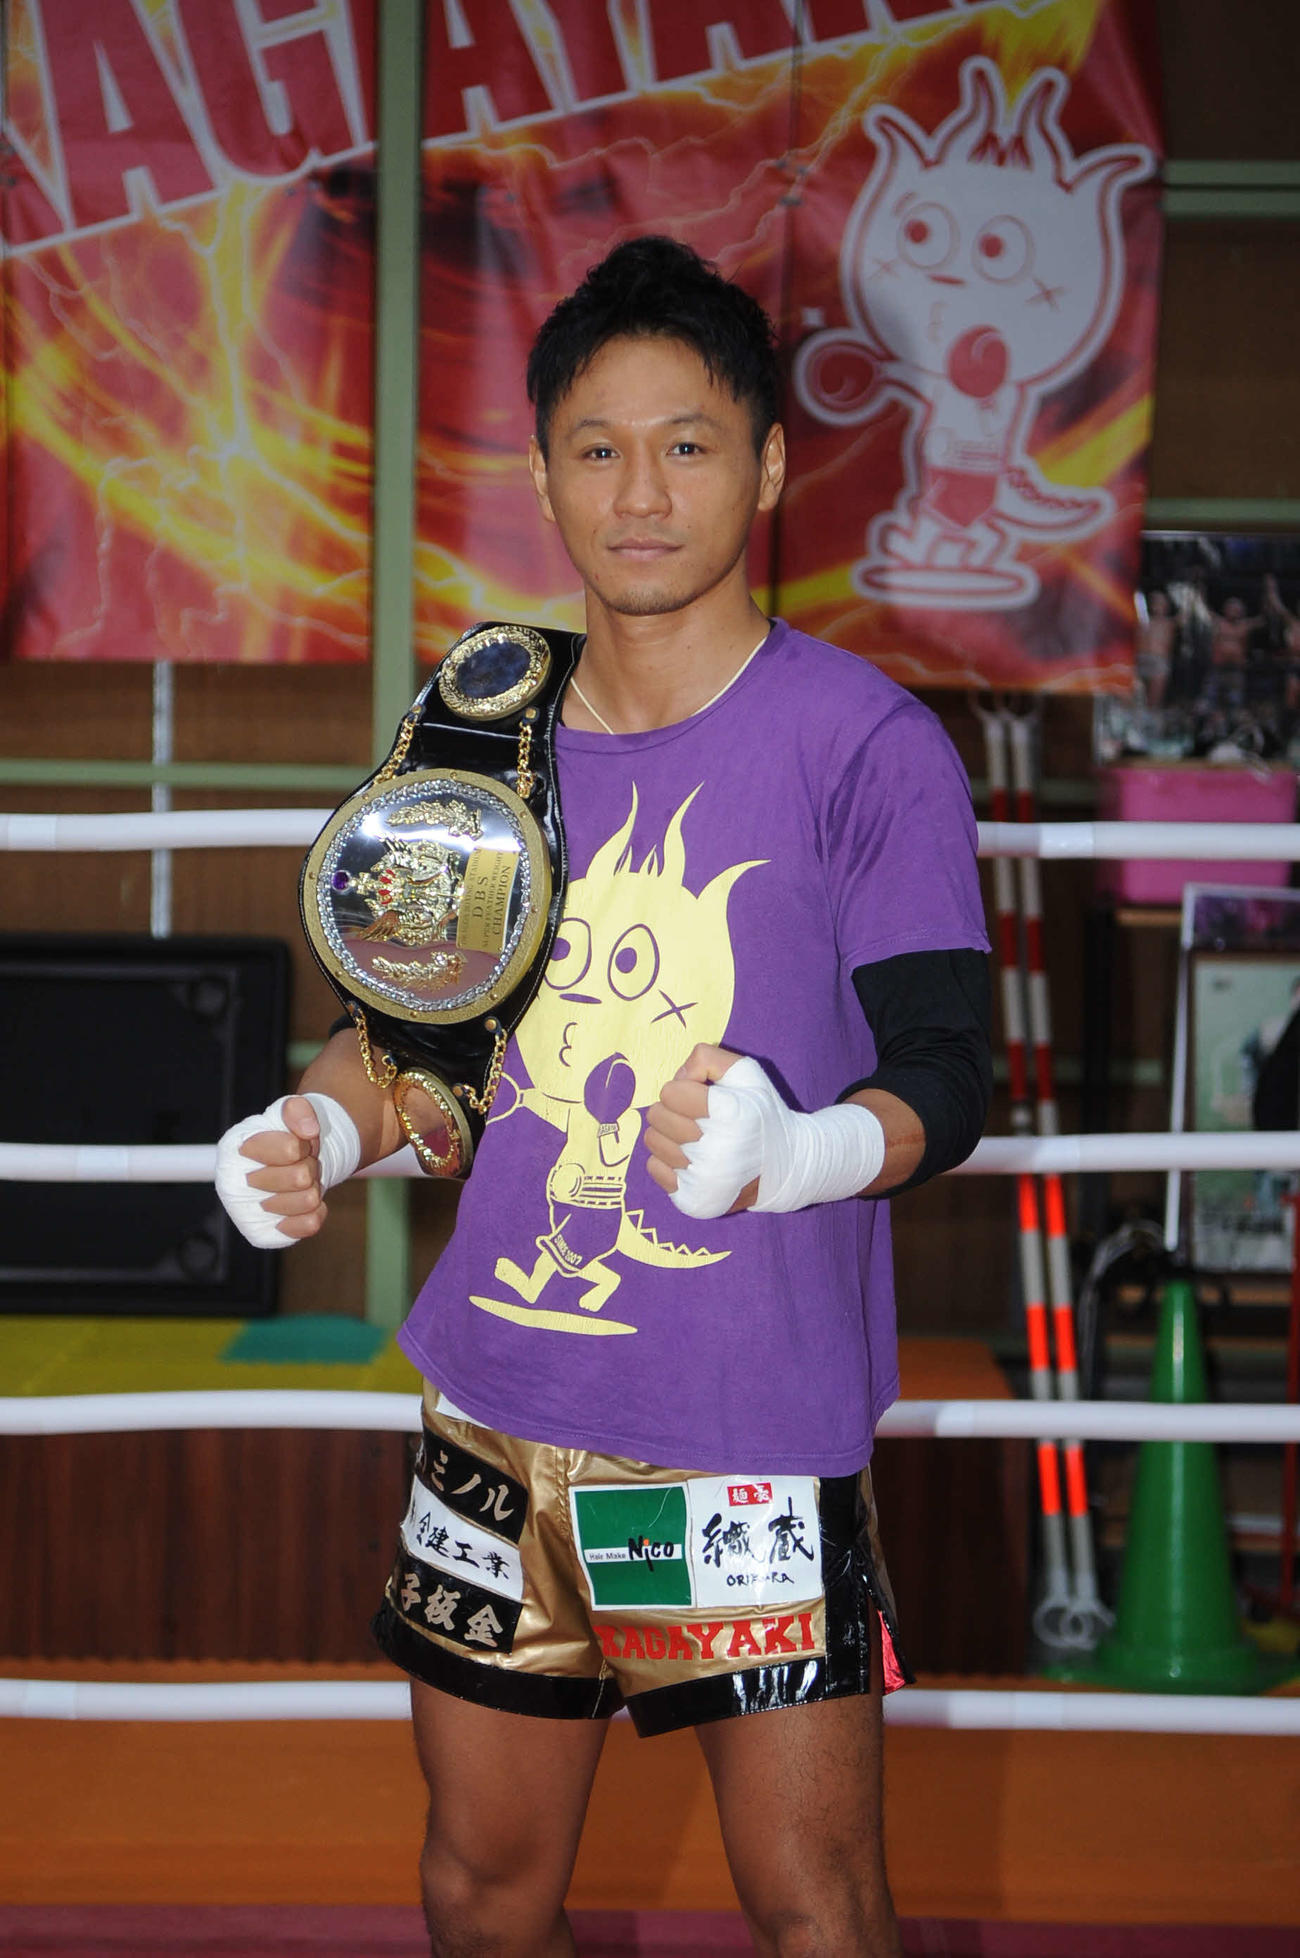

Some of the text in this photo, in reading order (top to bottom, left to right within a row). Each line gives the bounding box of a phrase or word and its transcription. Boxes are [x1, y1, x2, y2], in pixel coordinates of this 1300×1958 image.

[492, 866, 511, 936] CHAMPION
[606, 1551, 626, 1560] Make
[628, 1535, 674, 1572] Nico
[702, 1496, 814, 1568] 織蔵
[593, 1612, 815, 1660] KAGAYAKI
